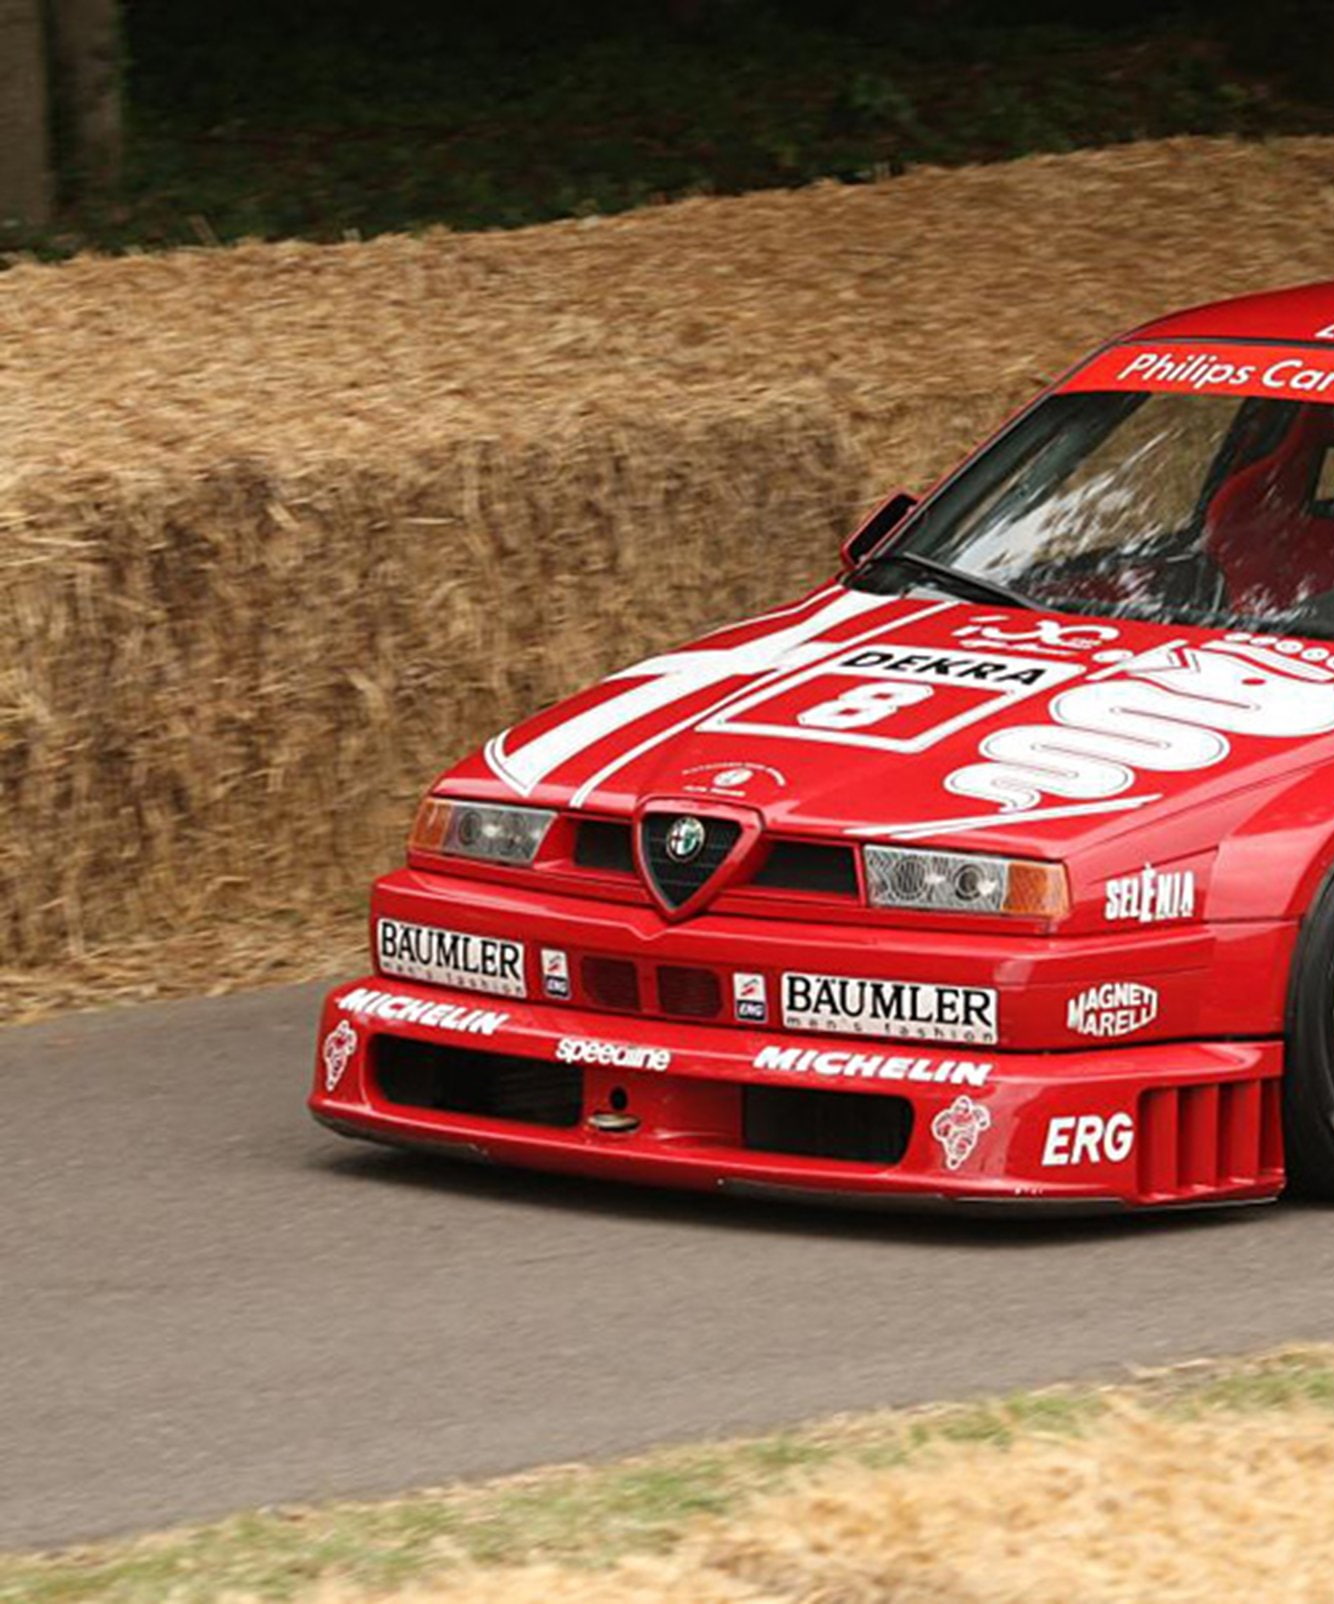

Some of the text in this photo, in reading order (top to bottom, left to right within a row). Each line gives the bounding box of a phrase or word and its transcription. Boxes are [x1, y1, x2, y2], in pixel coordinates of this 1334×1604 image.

[1117, 353, 1257, 386] Philips
[838, 651, 1047, 685] DEKRA
[797, 682, 935, 729] 8
[381, 921, 520, 980] BÄUMLER
[338, 988, 509, 1036] MICHELIN
[786, 976, 994, 1028] BÄUMLER
[556, 1037, 671, 1072] speedline
[753, 1046, 993, 1085] MICHELIN
[1042, 1112, 1134, 1166] ERG
